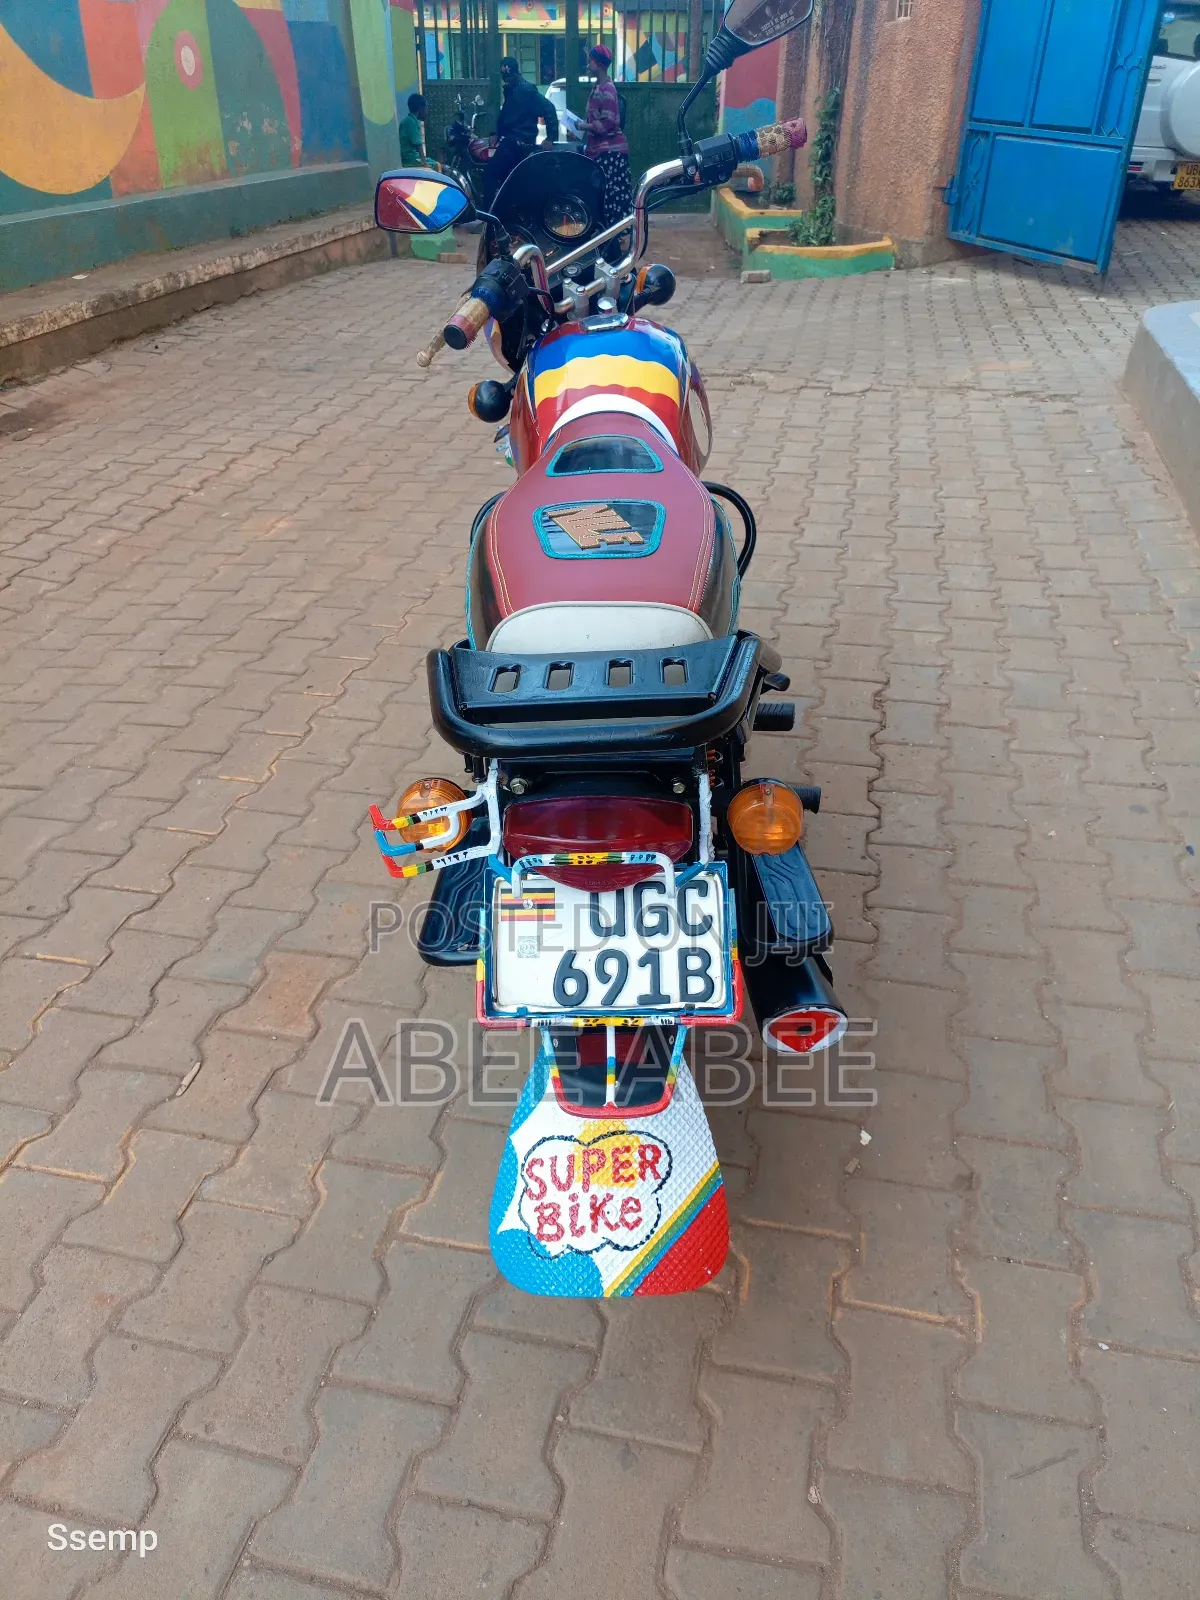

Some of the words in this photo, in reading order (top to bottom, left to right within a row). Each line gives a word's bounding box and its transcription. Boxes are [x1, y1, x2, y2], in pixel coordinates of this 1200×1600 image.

[1185, 164, 1200, 176] UB
[589, 879, 714, 938] UGC
[552, 947, 715, 1007] 691B
[525, 1143, 662, 1201] SUPER
